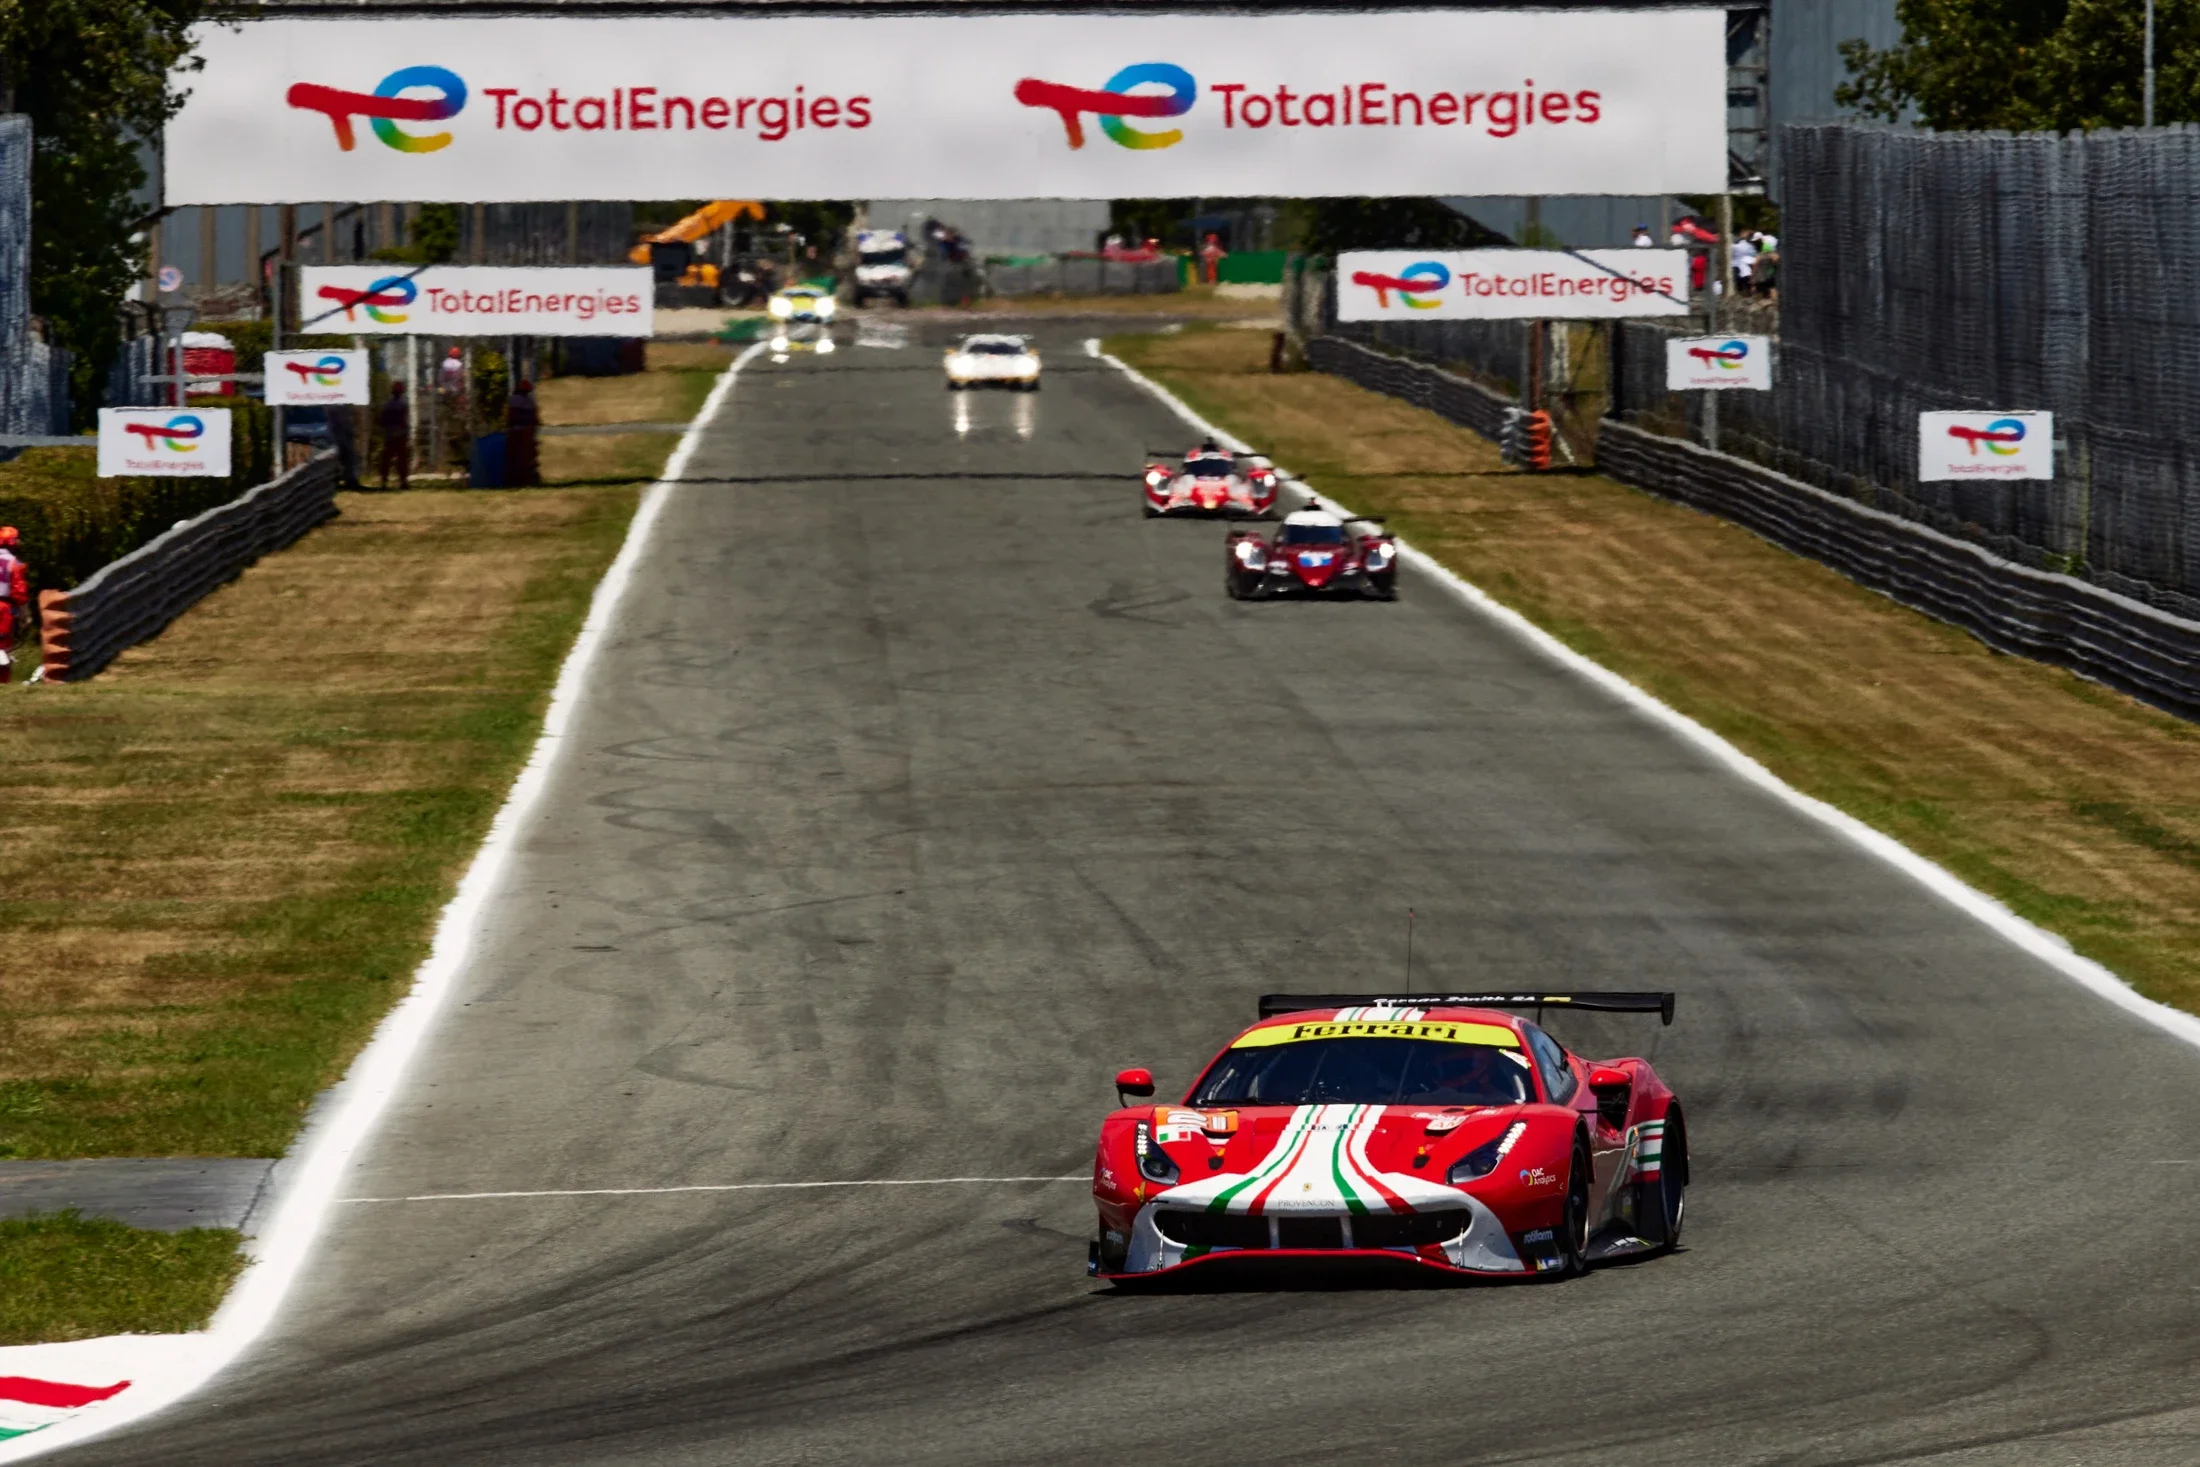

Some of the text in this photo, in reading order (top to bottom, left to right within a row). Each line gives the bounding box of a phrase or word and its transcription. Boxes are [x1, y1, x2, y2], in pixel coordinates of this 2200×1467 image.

[483, 85, 873, 141] TotalEnergies
[1210, 79, 1602, 138] TotalEnergies
[1458, 270, 1674, 302] TotalEnergies
[425, 288, 642, 320] TotalEnergies
[1287, 1024, 1460, 1041] Ferrari
